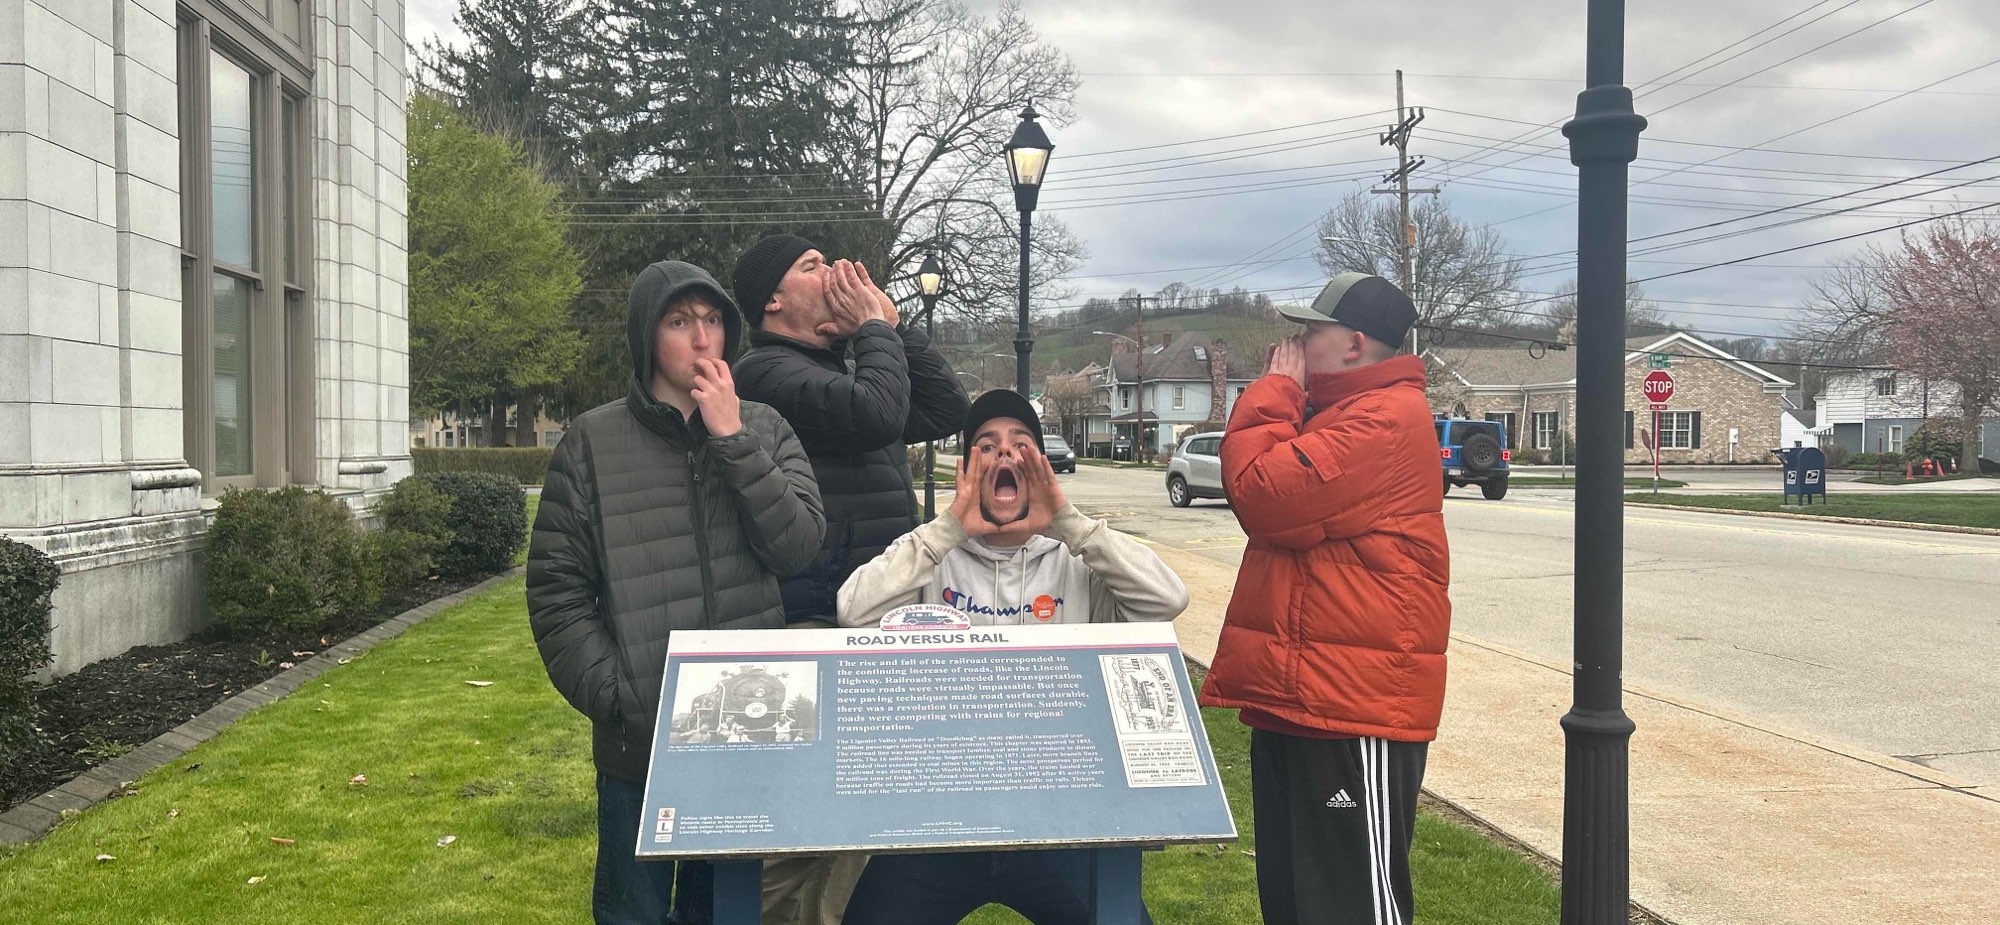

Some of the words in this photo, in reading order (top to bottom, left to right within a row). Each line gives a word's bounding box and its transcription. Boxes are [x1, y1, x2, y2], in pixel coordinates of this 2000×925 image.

[1645, 381, 1672, 393] STOP
[884, 606, 922, 623] LINCOLN
[925, 605, 968, 622] HIGHWAY
[846, 636, 896, 645] ROAD
[899, 634, 965, 644] VERSUS
[970, 633, 1009, 643] RAIL
[990, 656, 1053, 665] corresponded
[1131, 659, 1140, 670] 1877
[855, 667, 906, 676] continuing
[1153, 668, 1166, 680] END
[1013, 672, 1082, 682] transportation
[934, 684, 974, 692] virtually
[860, 695, 892, 703] paving
[896, 694, 948, 703] techniques
[1167, 693, 1174, 702] AN
[894, 712, 946, 721] competing
[1024, 710, 1063, 719] regional
[1166, 705, 1174, 717] ERA
[661, 823, 669, 831] L
